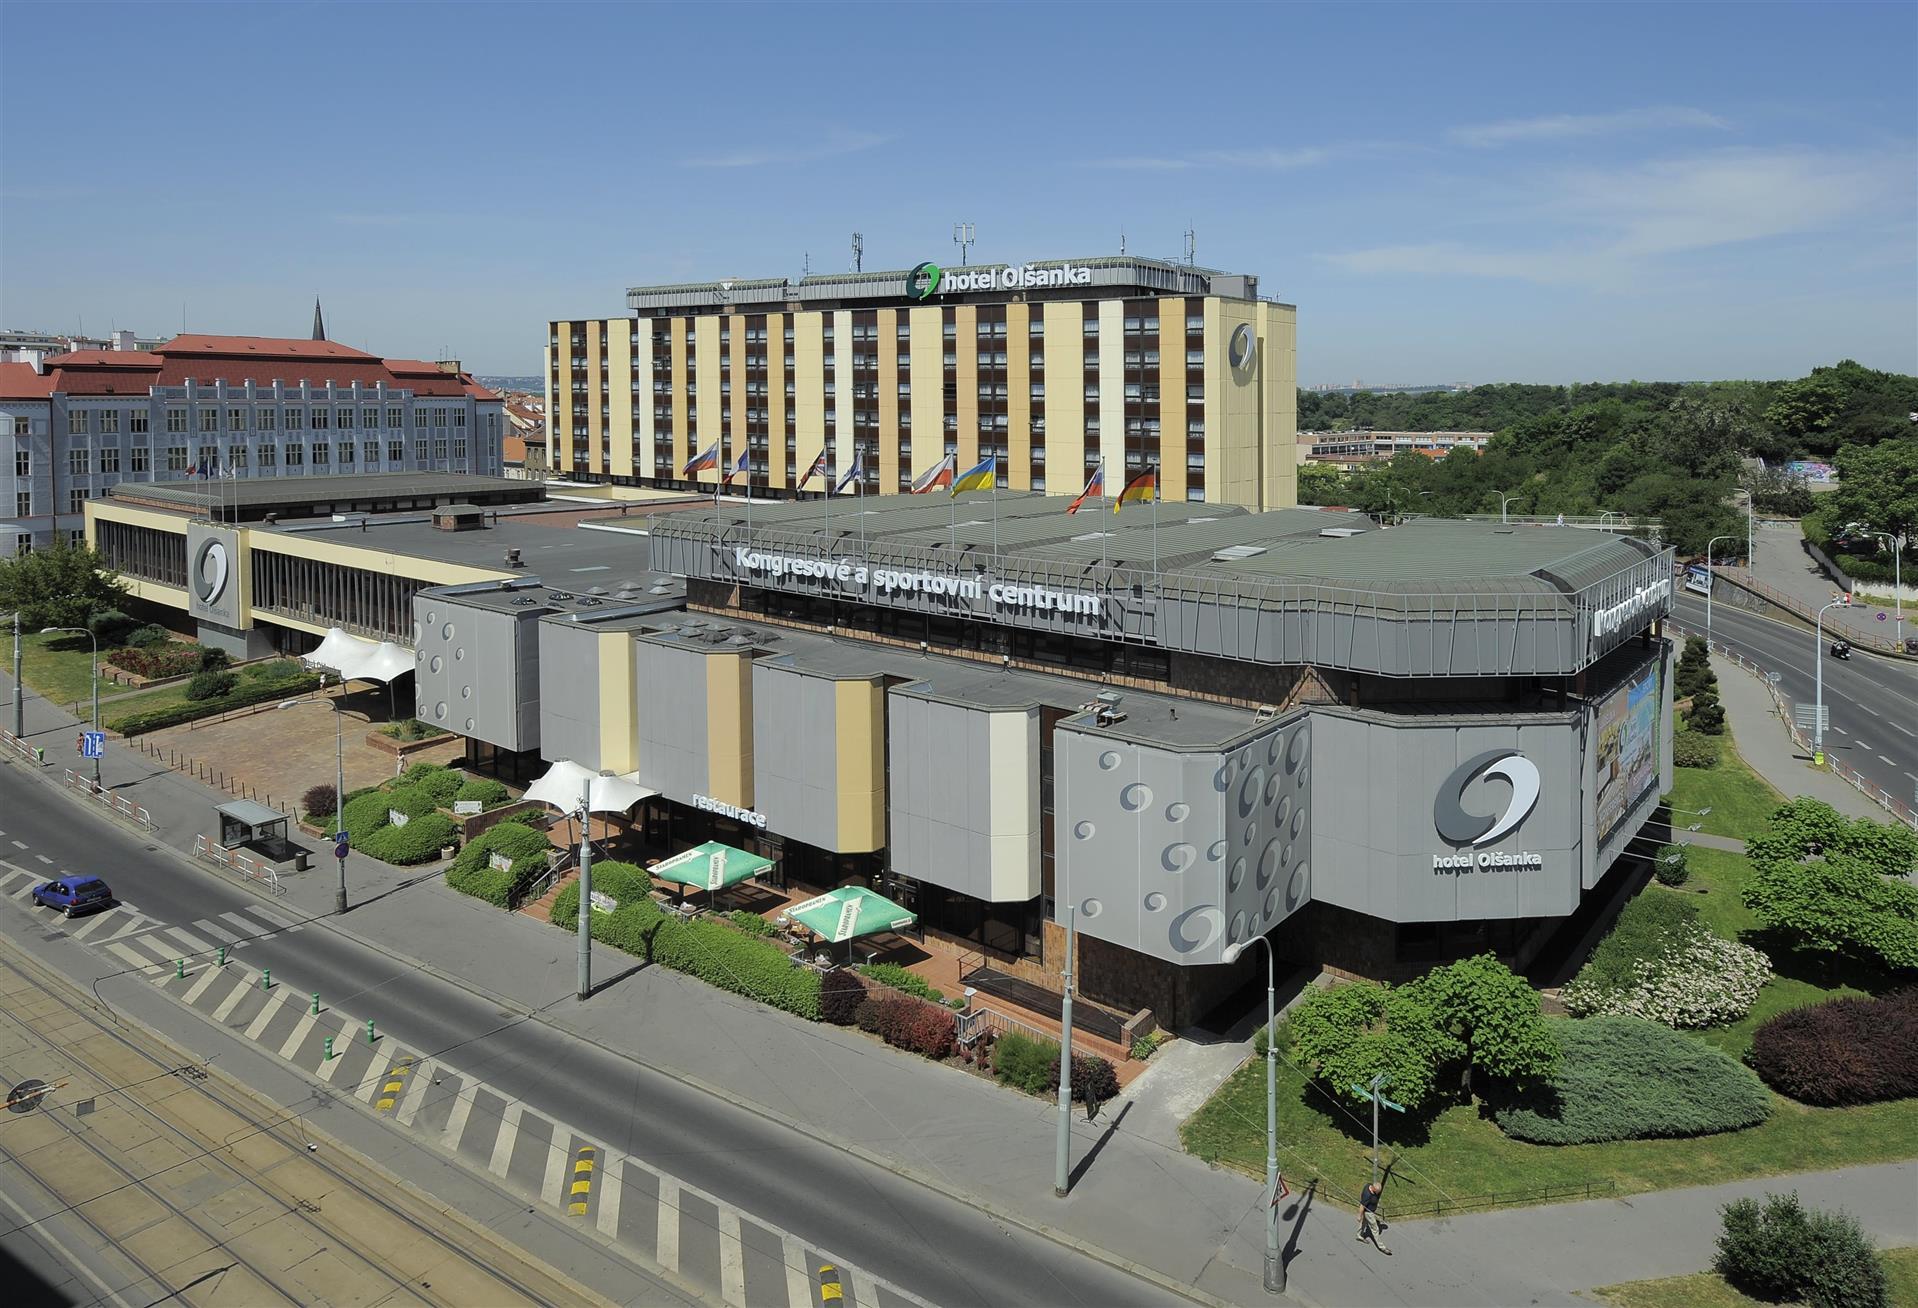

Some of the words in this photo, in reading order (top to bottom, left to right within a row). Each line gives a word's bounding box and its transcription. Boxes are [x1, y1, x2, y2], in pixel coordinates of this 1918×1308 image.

[945, 268, 996, 290] hotel
[1002, 263, 1092, 287] Olšanka
[736, 547, 850, 581] Kongresové
[854, 566, 869, 584] a
[873, 568, 984, 599] sportovní
[988, 583, 1102, 616] centrum
[692, 793, 767, 828] restaurace
[1432, 853, 1474, 868] hotel
[1477, 851, 1543, 867] Olšanka
